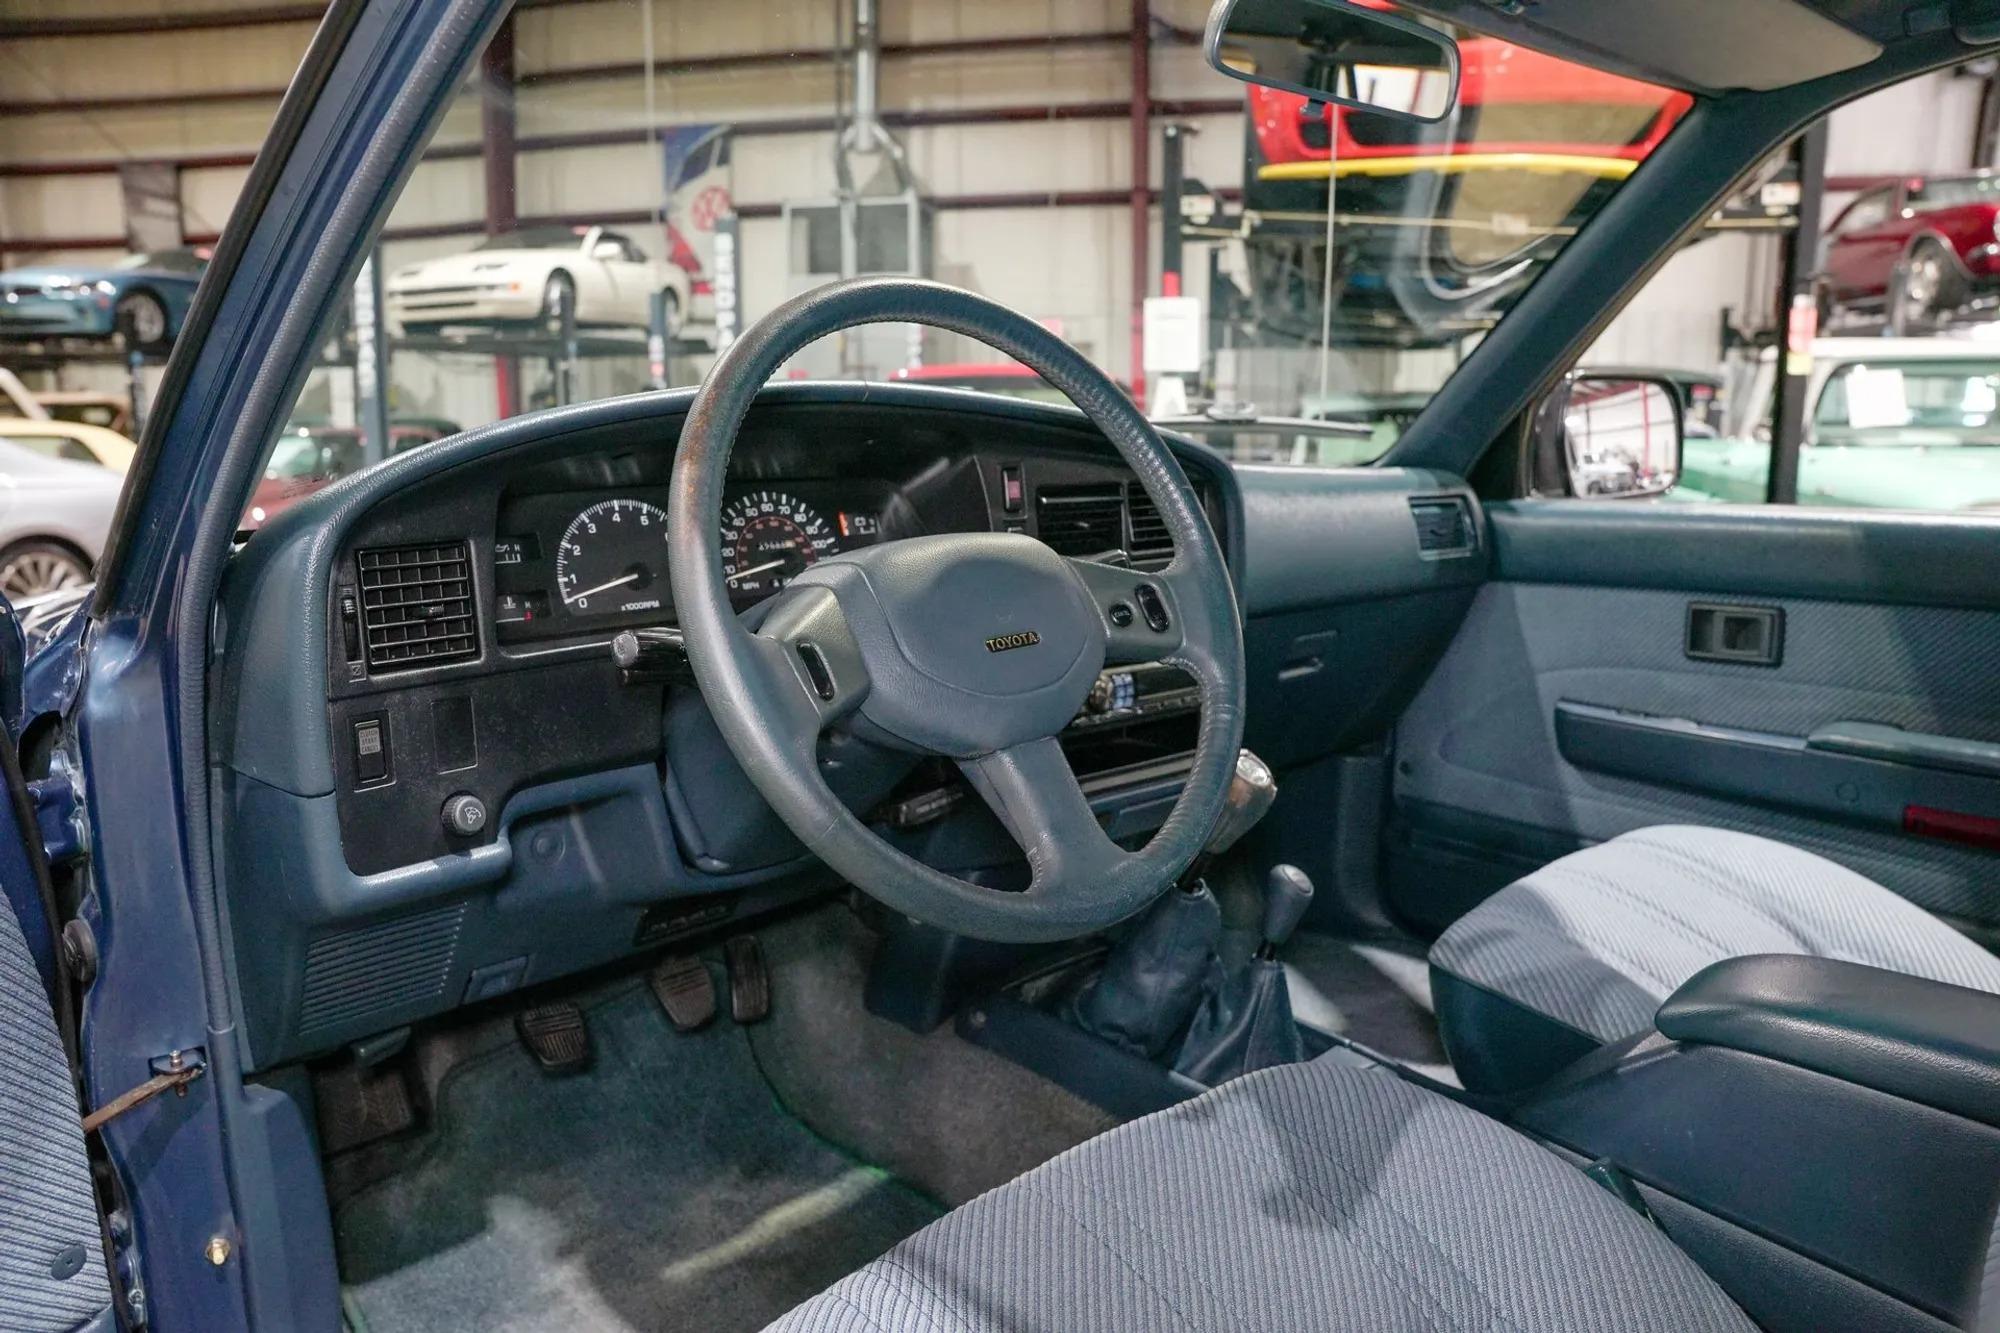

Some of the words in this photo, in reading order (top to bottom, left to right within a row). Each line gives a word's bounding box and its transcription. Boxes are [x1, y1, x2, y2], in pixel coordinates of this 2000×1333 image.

[745, 508, 758, 517] 50
[761, 503, 774, 513] 60
[778, 505, 791, 515] 70
[612, 513, 621, 523] 4
[640, 516, 649, 526] 5
[733, 517, 745, 527] 40
[588, 523, 597, 534] 3
[725, 531, 738, 541] 30
[812, 539, 827, 548] 100
[572, 545, 581, 556] 2
[722, 547, 735, 557] 20
[725, 565, 735, 575] 10
[569, 574, 577, 584] 1
[730, 579, 738, 589] 0
[742, 582, 760, 590] MPH
[578, 598, 588, 608] 0
[985, 632, 1038, 651] TOYOTA
